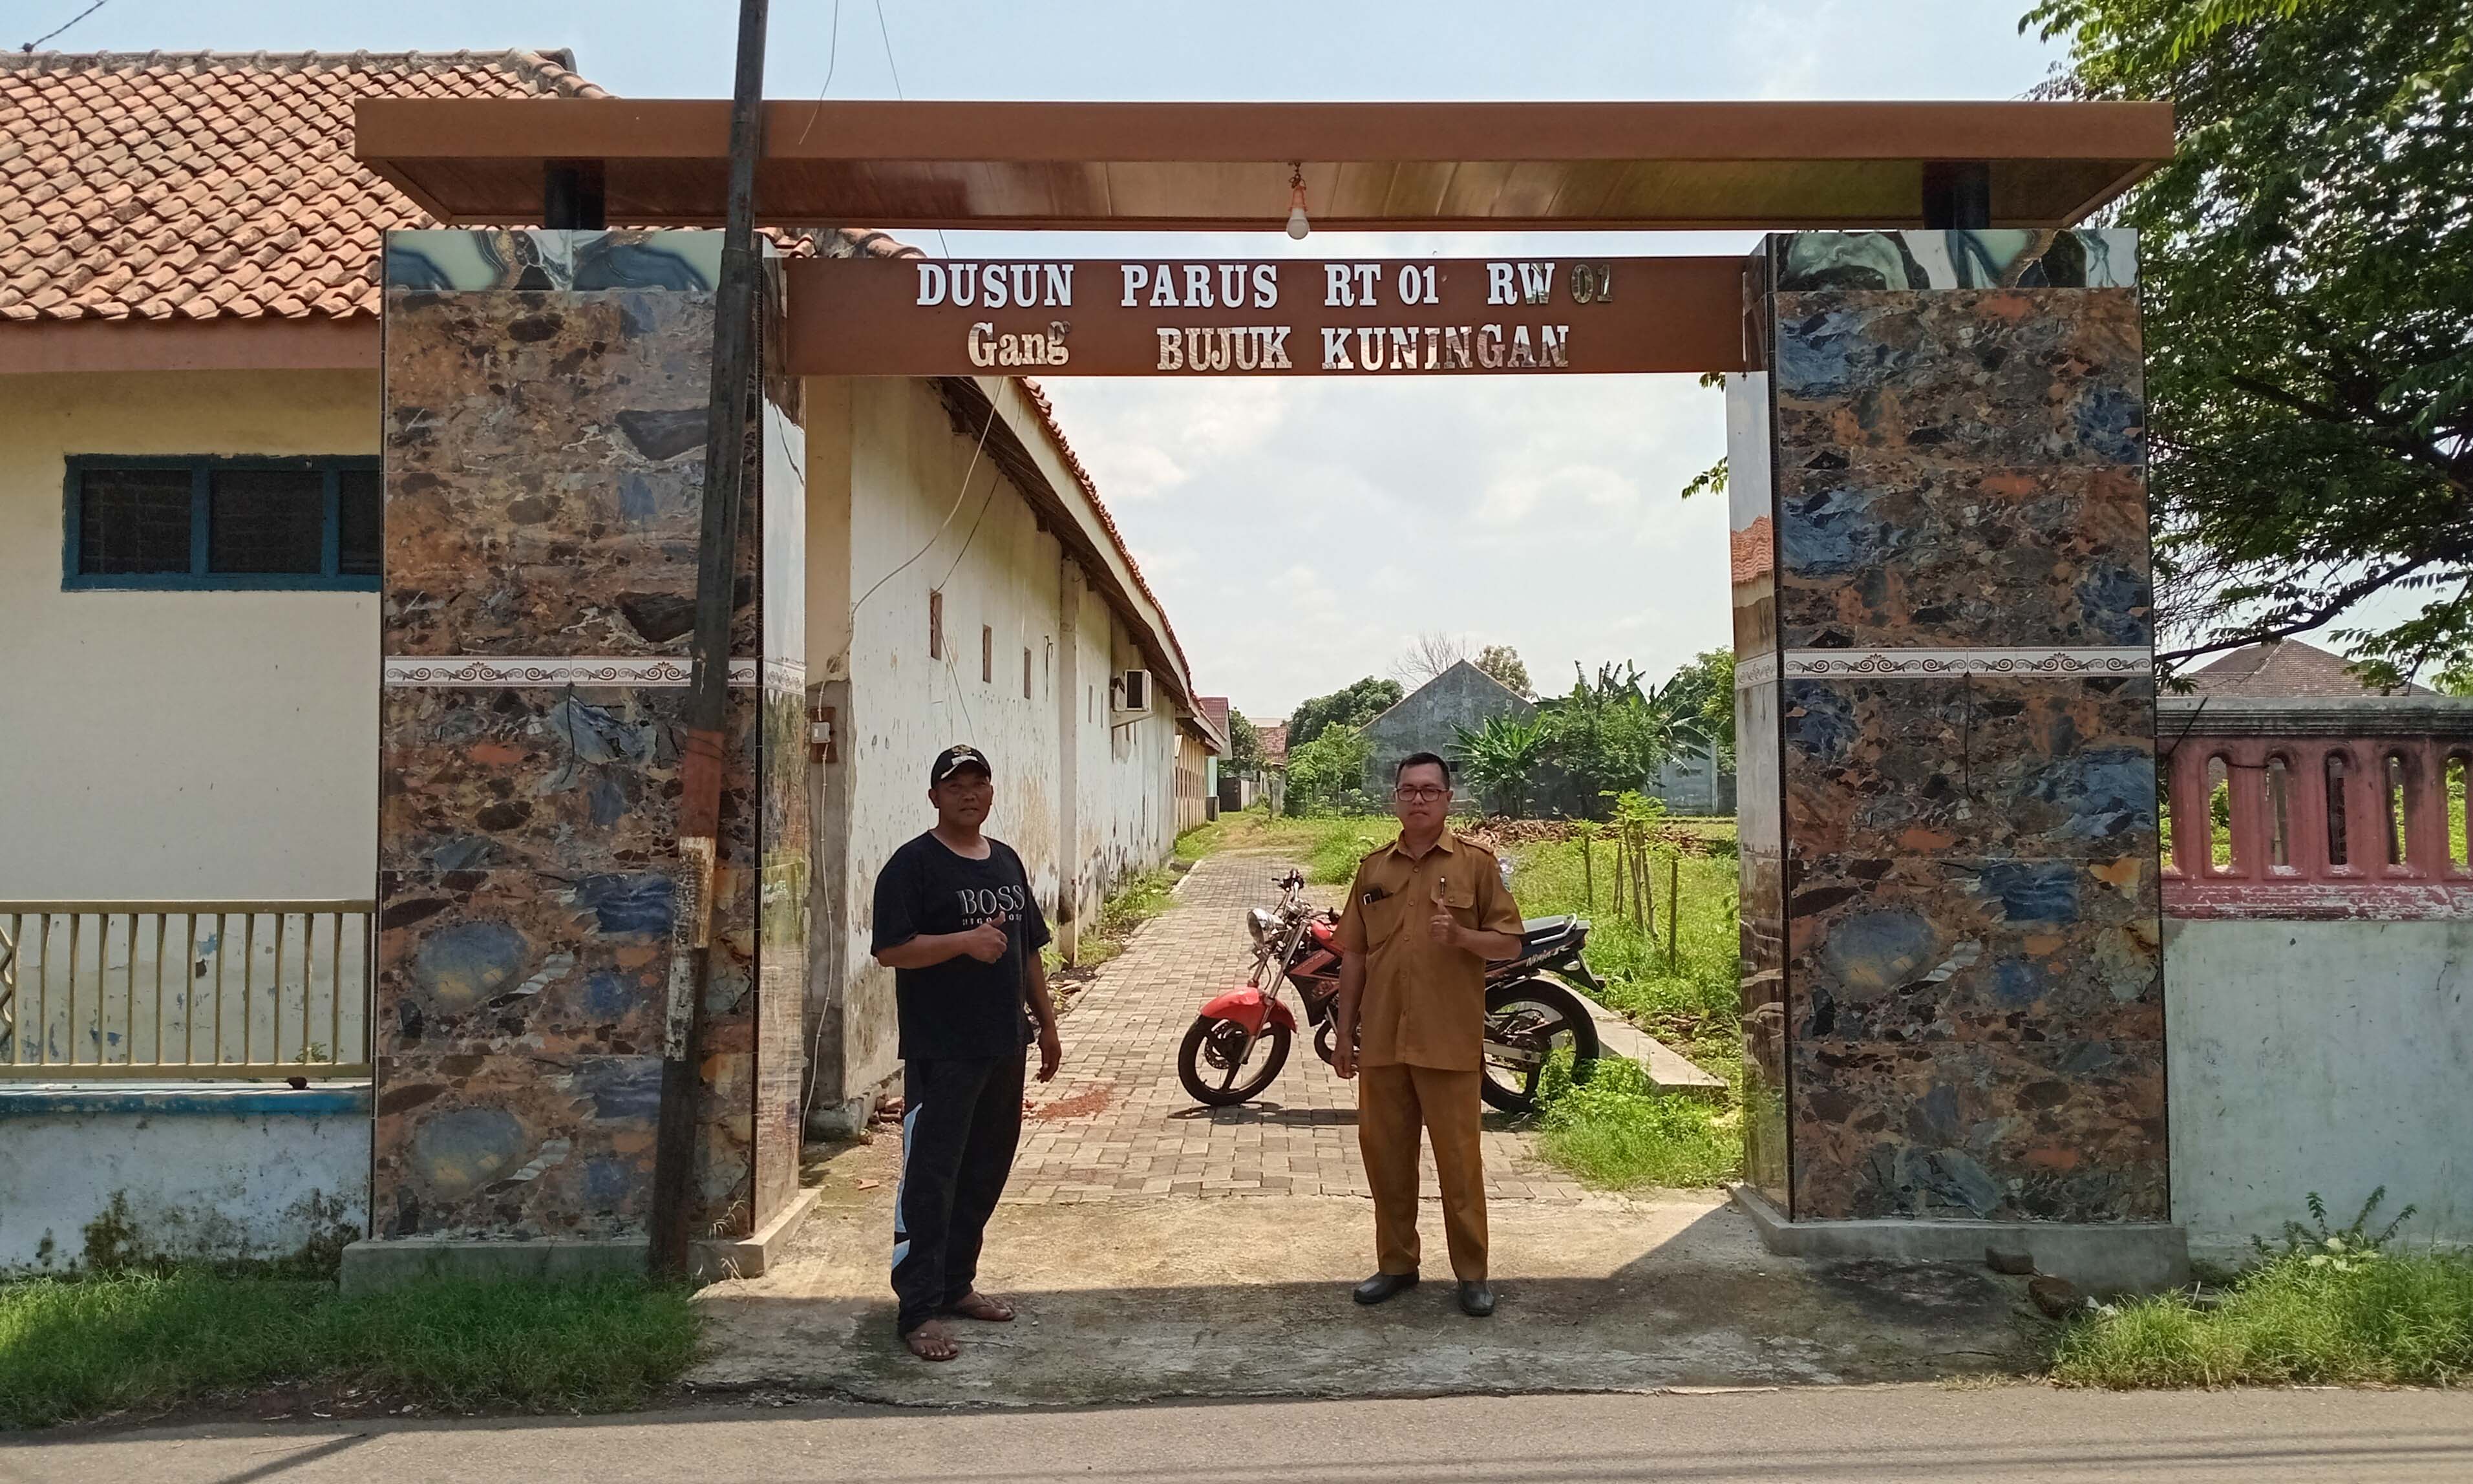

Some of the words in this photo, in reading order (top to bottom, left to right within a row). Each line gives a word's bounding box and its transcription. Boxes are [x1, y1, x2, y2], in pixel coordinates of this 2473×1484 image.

[917, 263, 1074, 308] DUSUN
[1121, 264, 1278, 308] PARUS
[1324, 264, 1381, 307] RT
[1398, 265, 1439, 305] 01
[1487, 263, 1555, 305] RW
[1571, 264, 1613, 304] 01
[968, 321, 1070, 367] Gang
[1156, 326, 1292, 371] BUJUK
[1321, 324, 1569, 370] KUNINGAN
[957, 885, 1024, 915] BOSS
